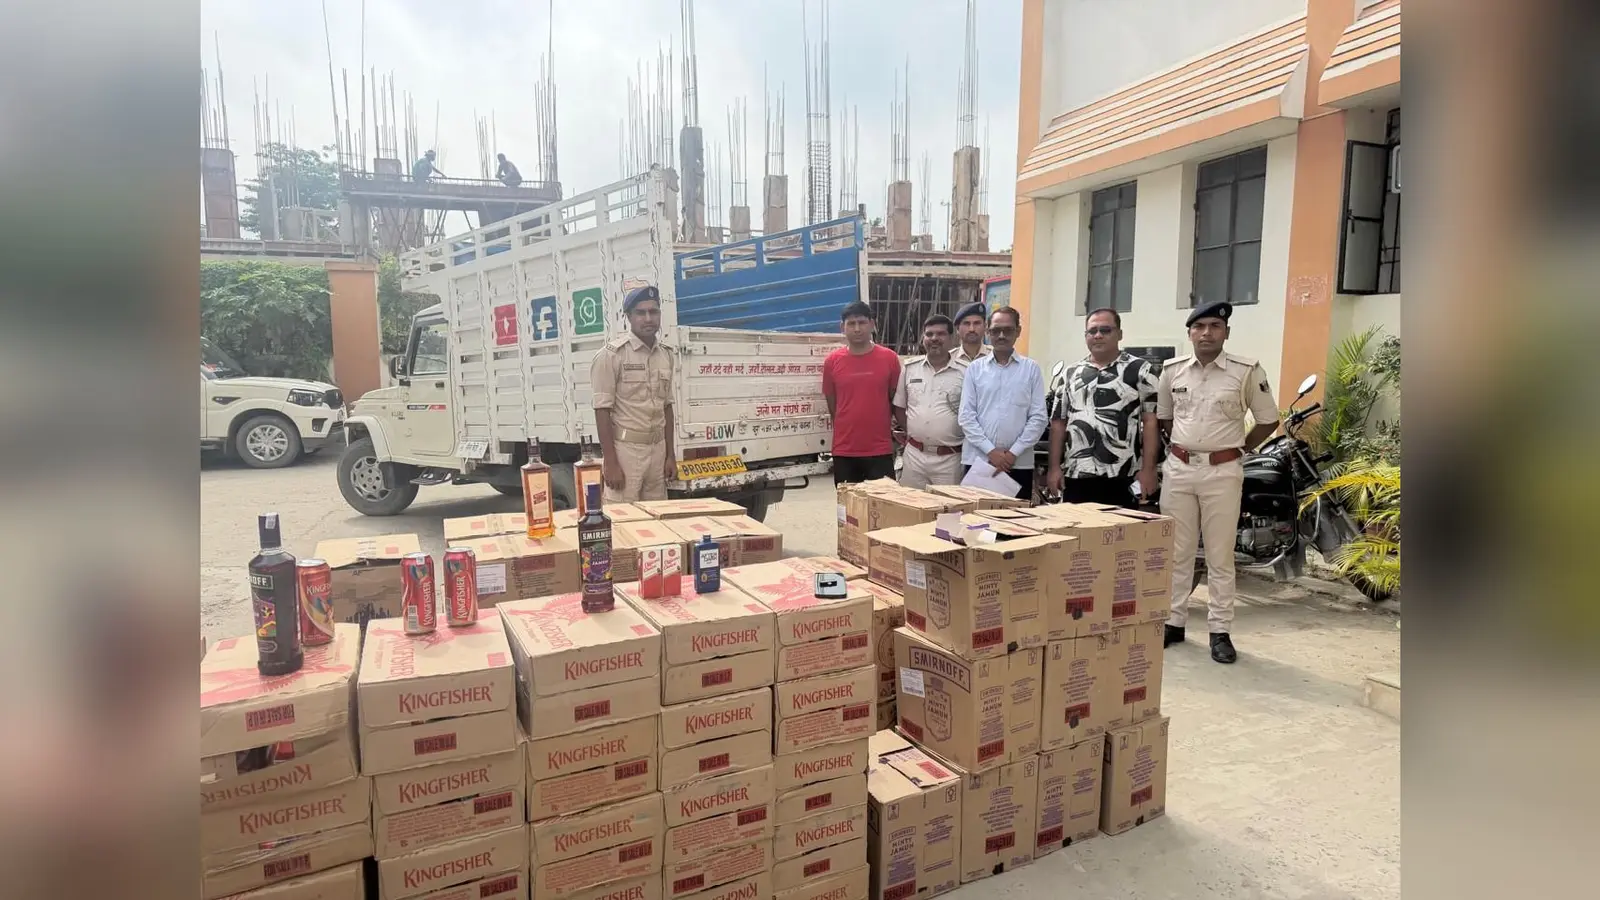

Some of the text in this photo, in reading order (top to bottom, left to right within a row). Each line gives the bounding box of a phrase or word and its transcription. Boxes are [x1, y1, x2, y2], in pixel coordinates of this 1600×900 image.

[706, 424, 736, 440] BLOW
[423, 581, 434, 626] KINGFISHER
[457, 575, 468, 619] KINGFISHER
[692, 629, 759, 653] KINGFISHER
[792, 614, 853, 639] KINGFISHER
[564, 651, 644, 681] KINGFISHER
[914, 651, 964, 682] SMIRNOFF
[399, 684, 492, 714] KINGFISHER
[792, 684, 853, 710] KINGFISHER
[685, 706, 753, 734] KINGFISHER
[547, 738, 627, 771] KINGFISHER
[794, 755, 853, 780] KINGFISHER
[201, 763, 313, 806] KINGFISHER
[398, 768, 490, 804] KINGFISHER
[239, 798, 346, 835] KINGFISHER
[680, 787, 750, 818] KINGFISHER
[554, 820, 634, 852] KINGFISHER
[795, 819, 854, 847] KINGFISHER
[403, 850, 494, 888] KINGFISHER
